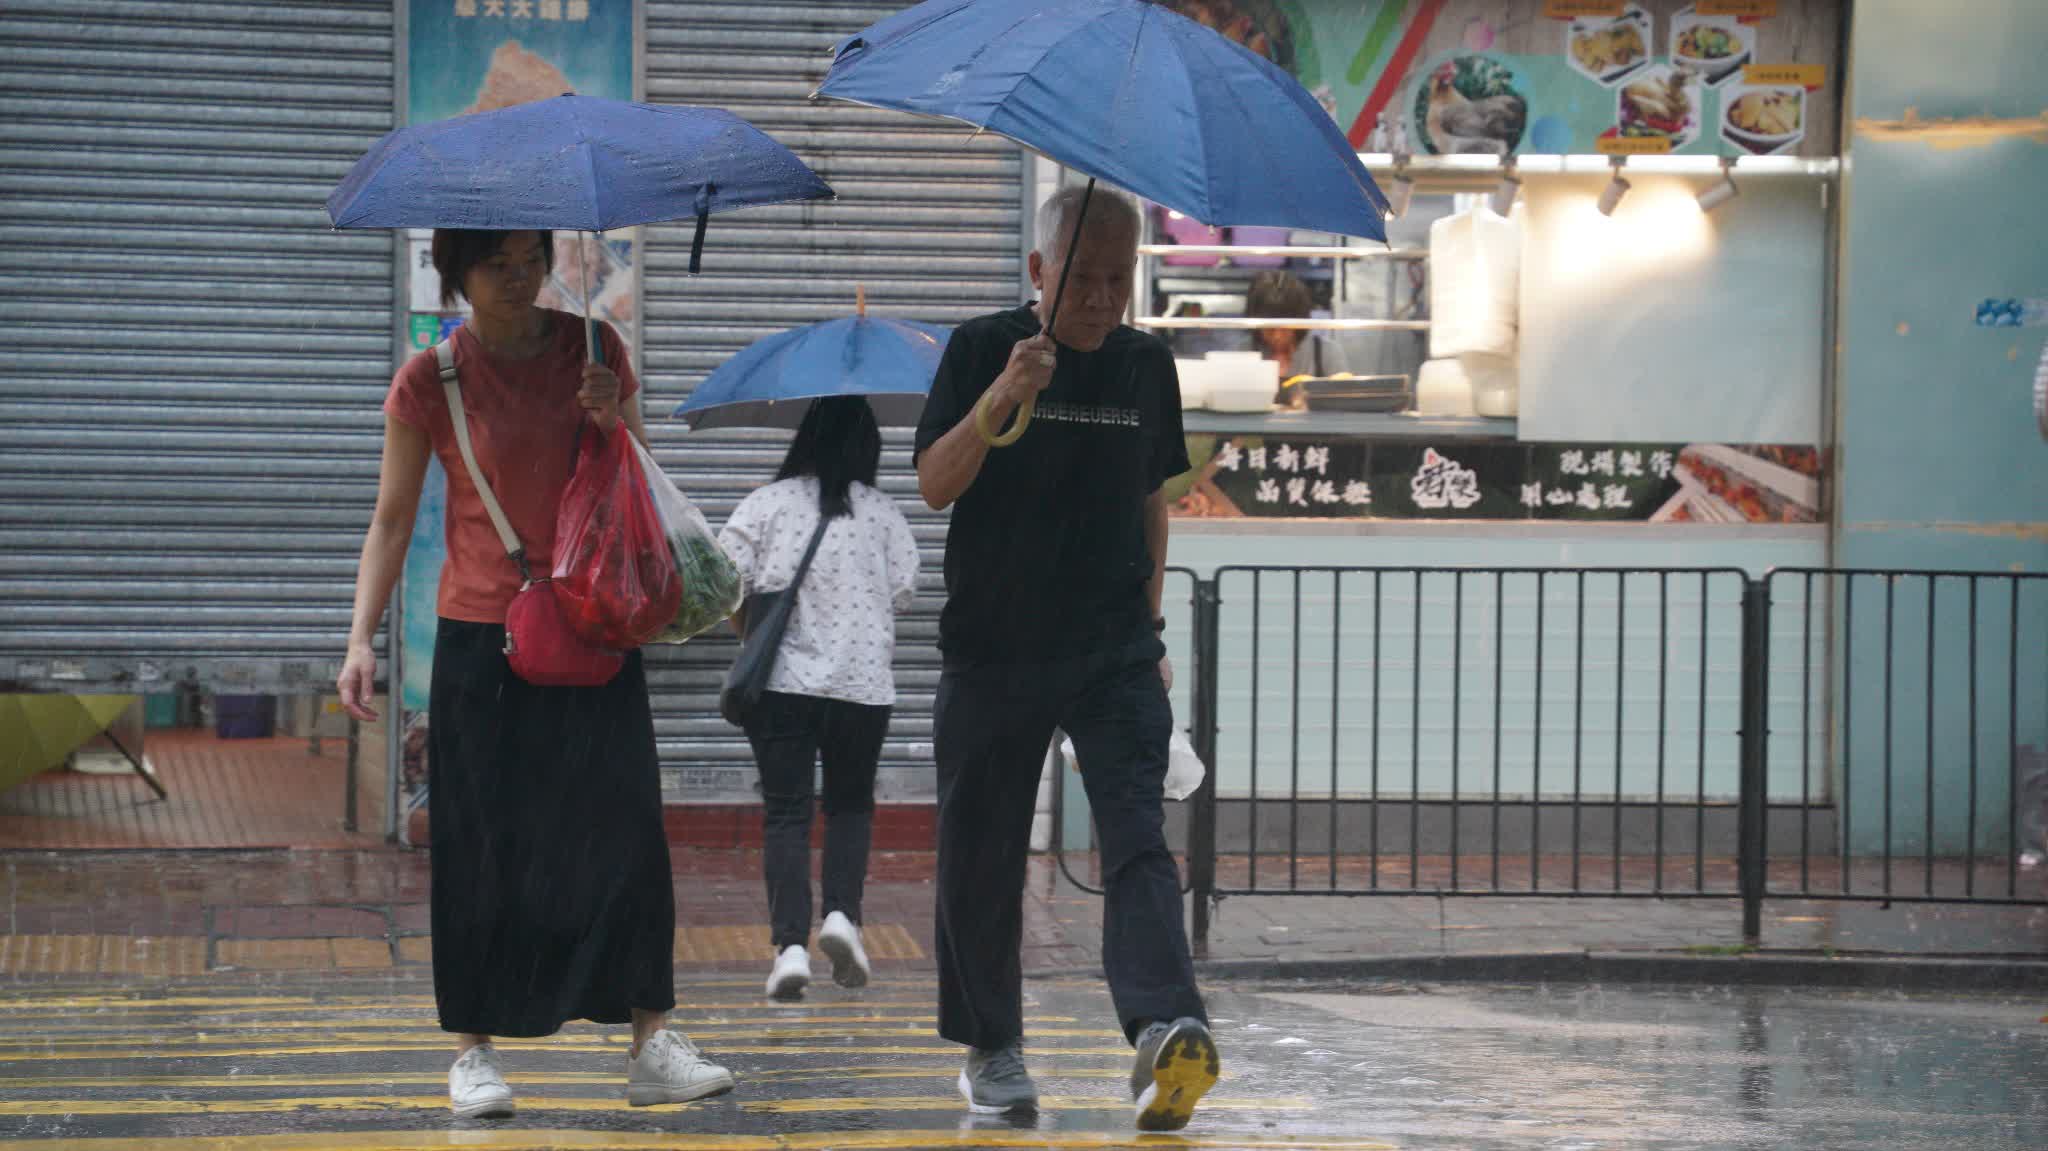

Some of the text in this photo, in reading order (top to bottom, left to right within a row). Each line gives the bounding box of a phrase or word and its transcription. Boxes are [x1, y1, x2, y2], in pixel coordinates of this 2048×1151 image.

[1216, 441, 1329, 475] 每日新鮮
[1560, 449, 1673, 479] 現場製作
[1255, 477, 1372, 507] 品質保證
